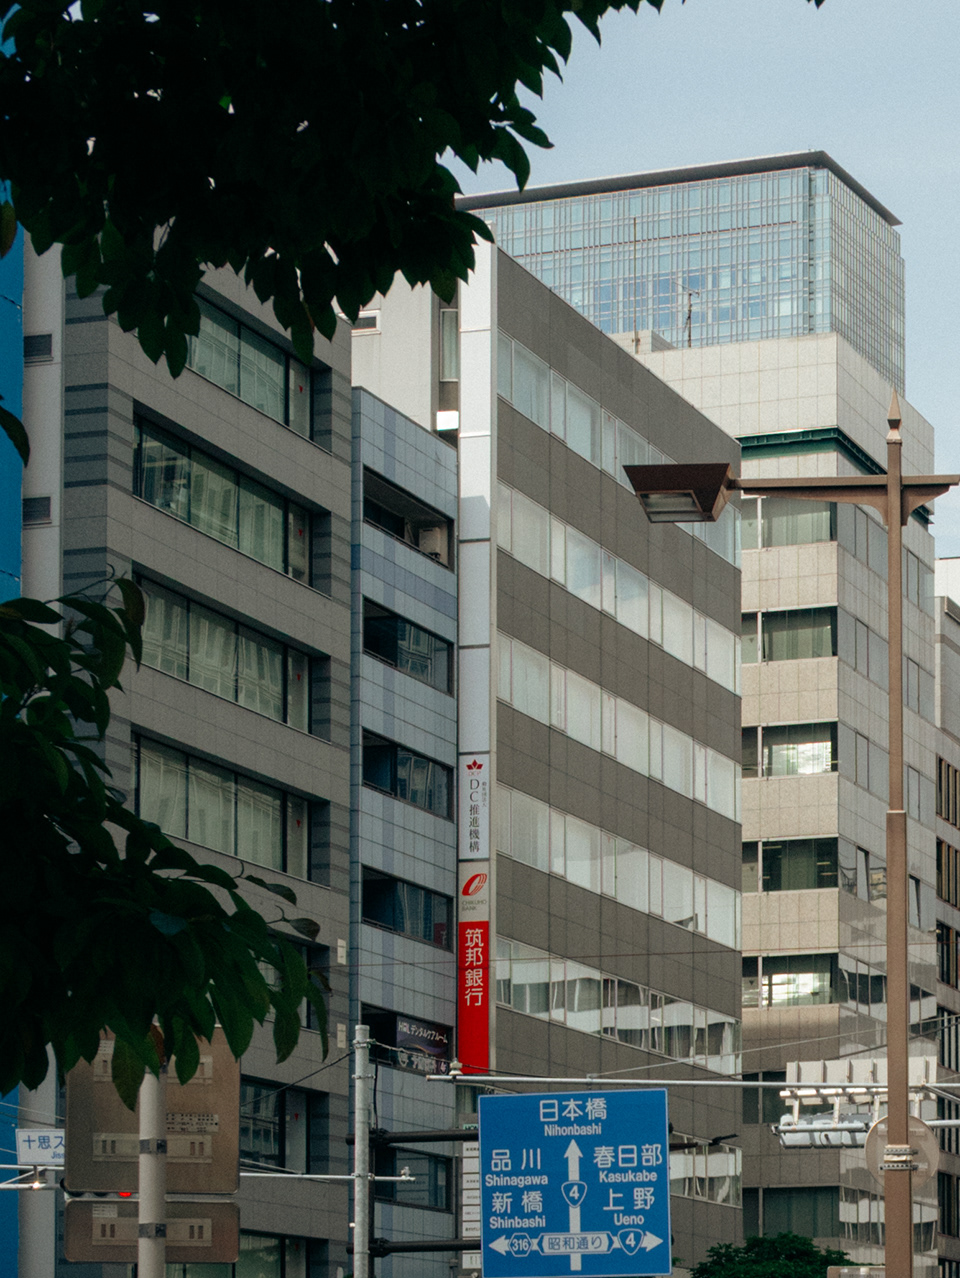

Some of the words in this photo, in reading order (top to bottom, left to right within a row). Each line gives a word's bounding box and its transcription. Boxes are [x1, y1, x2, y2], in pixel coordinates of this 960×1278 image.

[468, 778, 480, 853] DC推進機構
[464, 928, 484, 1007] 筑邦銀行
[539, 1097, 608, 1122] 日本橋
[543, 1123, 602, 1137] Nihonbashi
[491, 1148, 542, 1172] 品川
[593, 1143, 663, 1169] 春日部
[485, 1174, 549, 1188] Shinagawa
[599, 1170, 658, 1184] Kasukabe
[569, 1185, 580, 1200] 4
[602, 1187, 655, 1211] 上野
[491, 1190, 543, 1215] 新橋
[489, 1215, 547, 1230] Shinbashi
[613, 1213, 645, 1226] Ueno
[510, 1238, 530, 1252] 316
[547, 1235, 603, 1251] 昭和通り
[625, 1232, 636, 1248] 4
